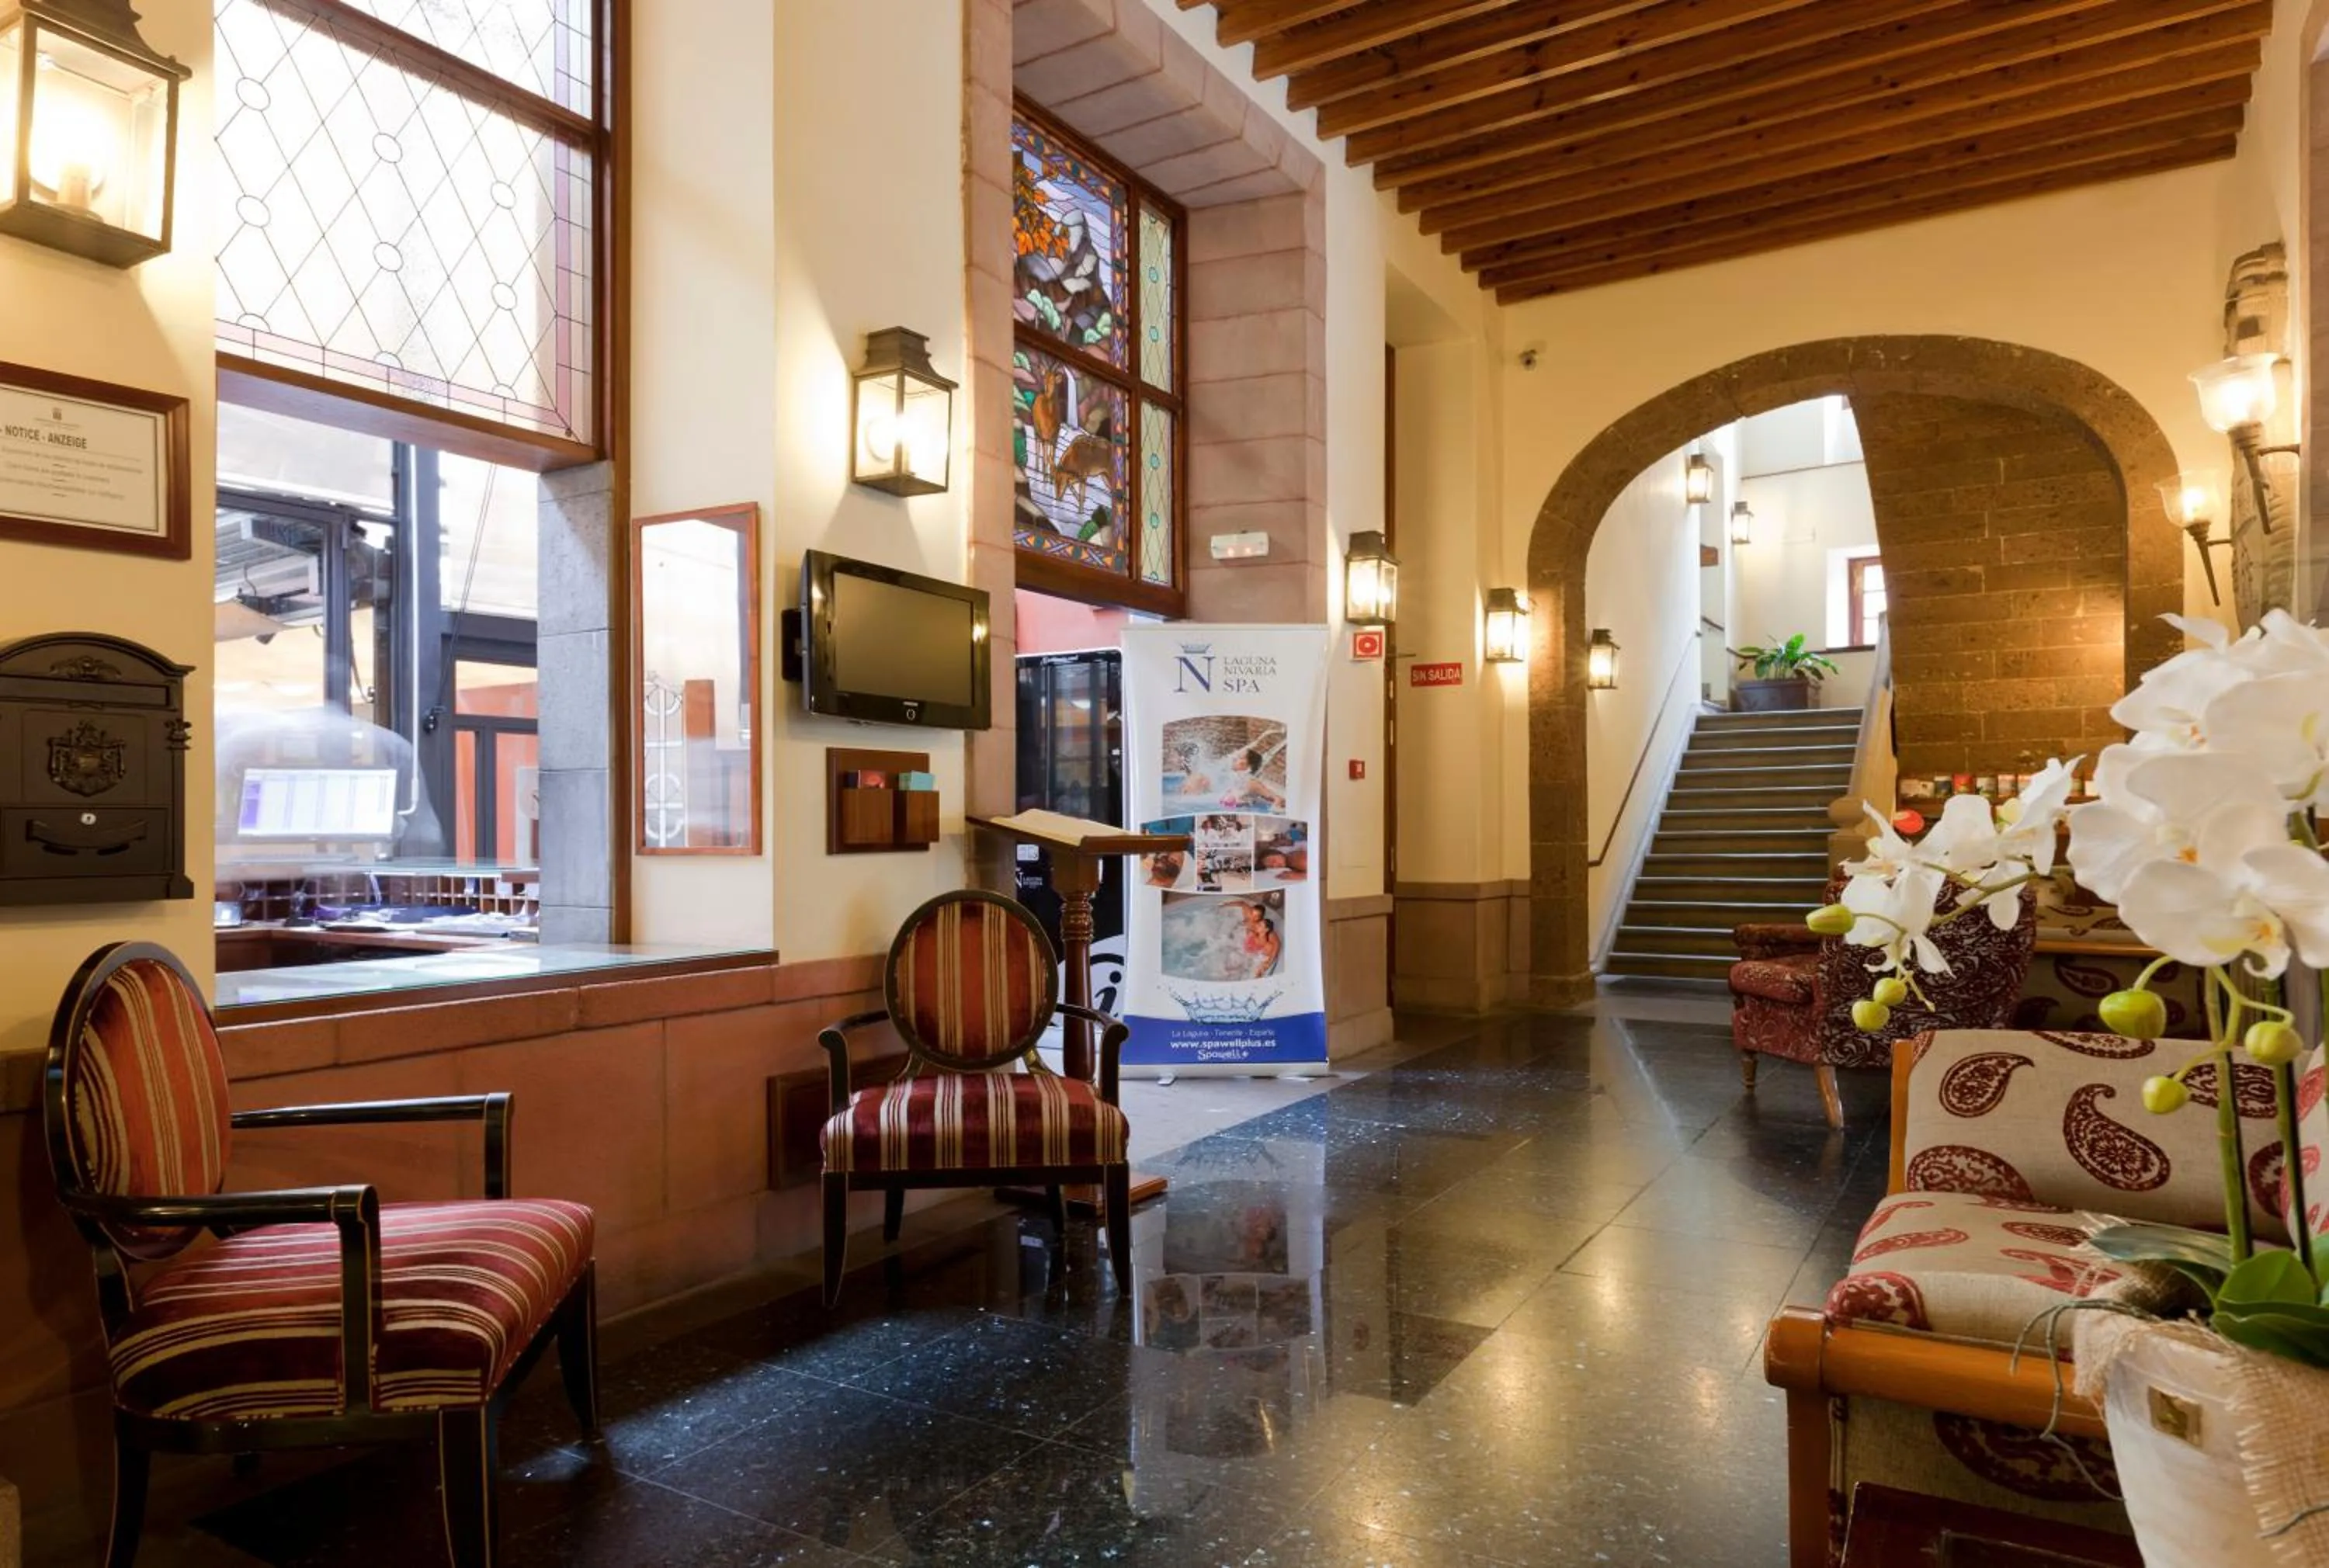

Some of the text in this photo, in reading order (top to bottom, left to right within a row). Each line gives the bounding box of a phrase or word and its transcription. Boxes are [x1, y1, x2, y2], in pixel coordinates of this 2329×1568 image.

[5, 425, 40, 441] NOTICE
[47, 432, 88, 449] ANZEIGE
[1223, 656, 1277, 666] LAGUNA
[1173, 656, 1216, 693] N
[1224, 666, 1278, 676] NIVARIA
[1412, 667, 1462, 682] SIN SALIDA
[1223, 678, 1260, 693] SPA
[1170, 1039, 1276, 1049] www.spawellplus.es
